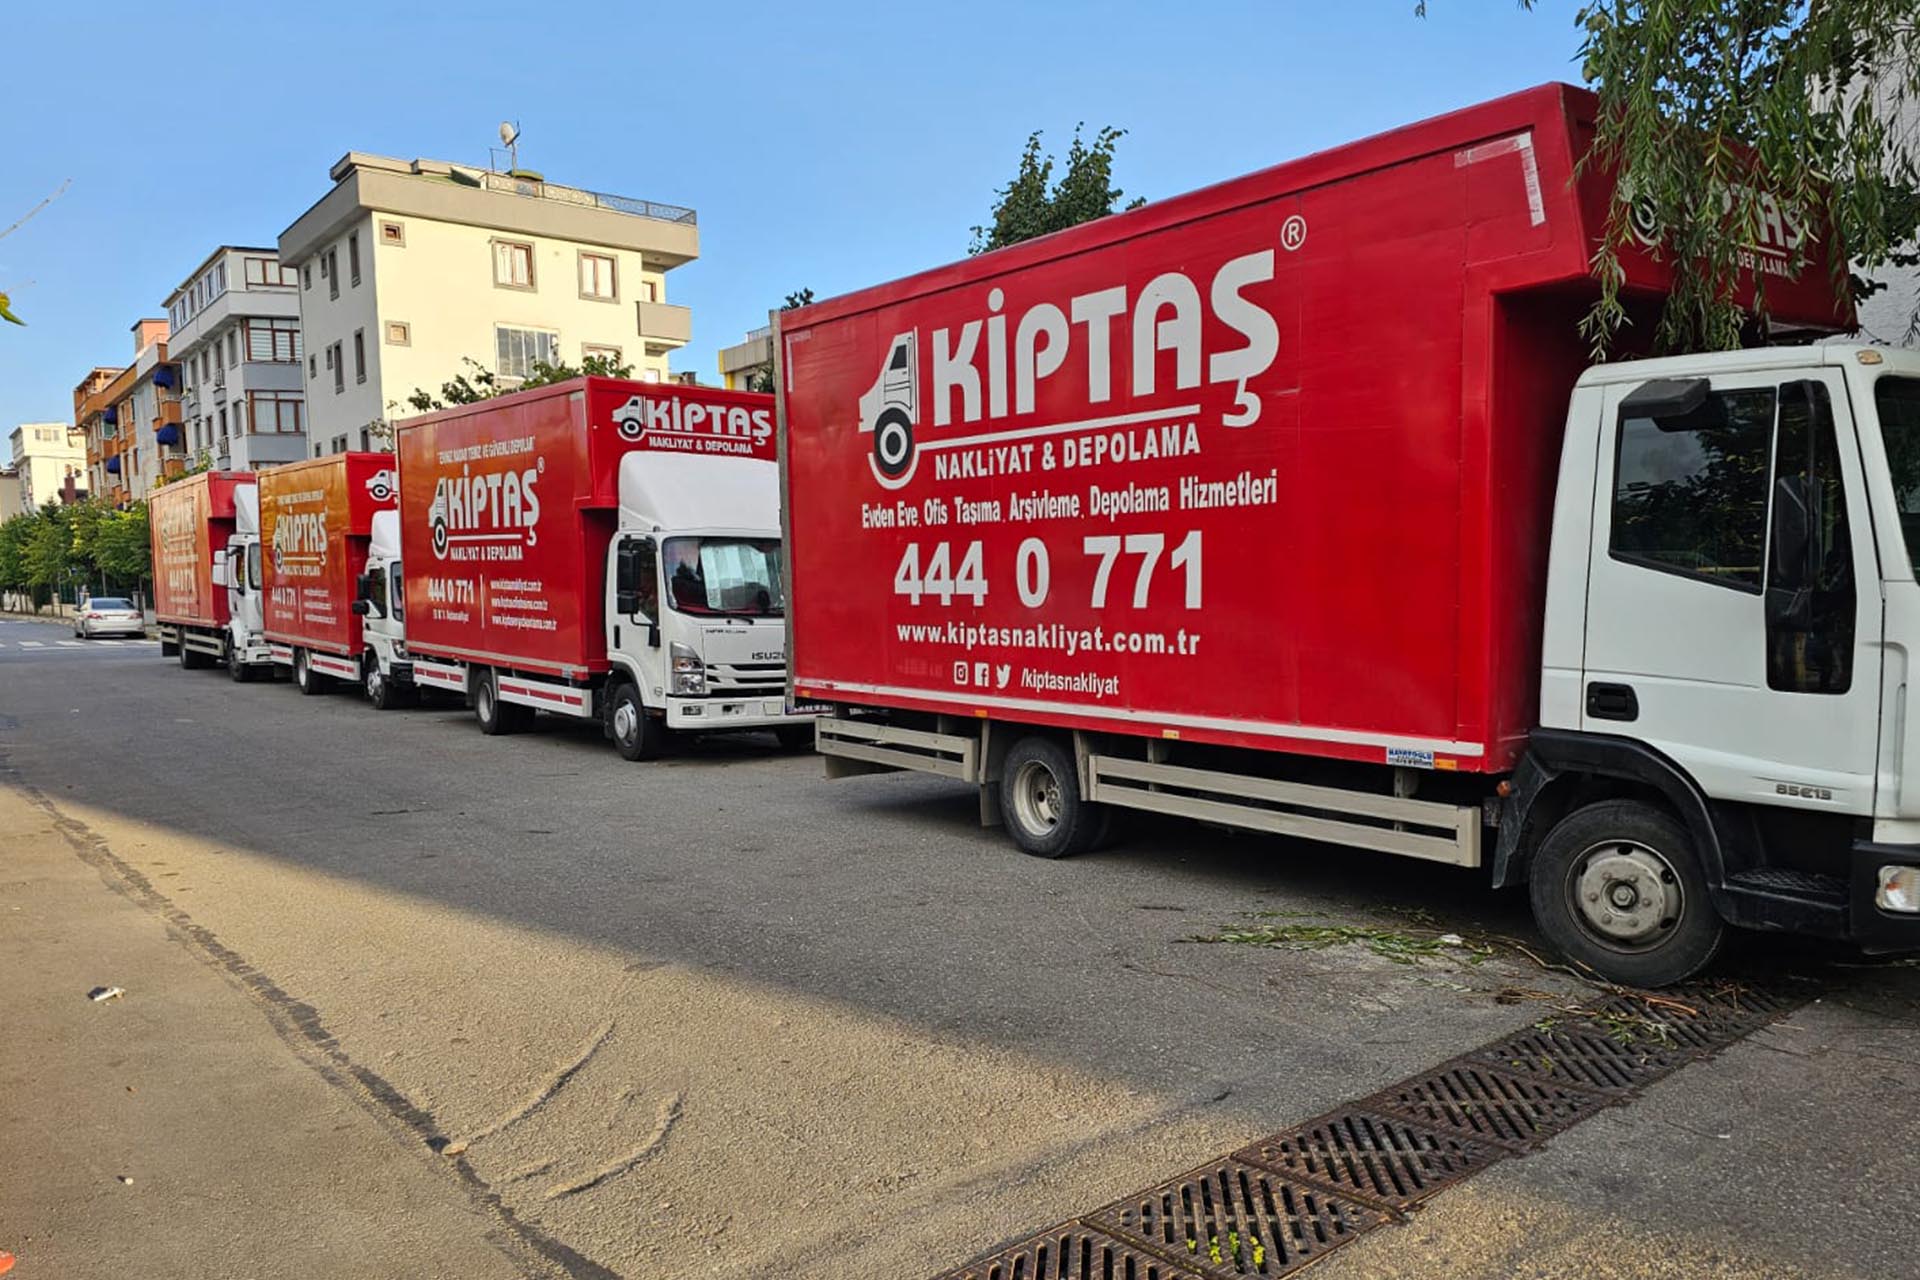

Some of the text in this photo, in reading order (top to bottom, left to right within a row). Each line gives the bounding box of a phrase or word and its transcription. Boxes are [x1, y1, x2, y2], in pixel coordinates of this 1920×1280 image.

[933, 248, 1280, 428] KİPTAŞ
[647, 396, 772, 446] KİPTAŞ
[705, 440, 753, 454] DEPOLAMA
[1041, 441, 1057, 471] &
[1063, 423, 1201, 469] DEPOLAMA
[447, 463, 540, 546] KİPTAŞ
[862, 503, 895, 529] Evden
[924, 498, 948, 526] Ofis
[1090, 482, 1170, 523] Depolama
[1180, 468, 1277, 510] Hizmetleri
[428, 578, 446, 602] 444
[447, 578, 454, 603] 0
[456, 579, 475, 604] 771
[894, 530, 1202, 610] 444 0 771
[896, 621, 1201, 657] www.kiptasnakliyat.com.tr
[1020, 667, 1120, 699] /kiptasnakliyat
